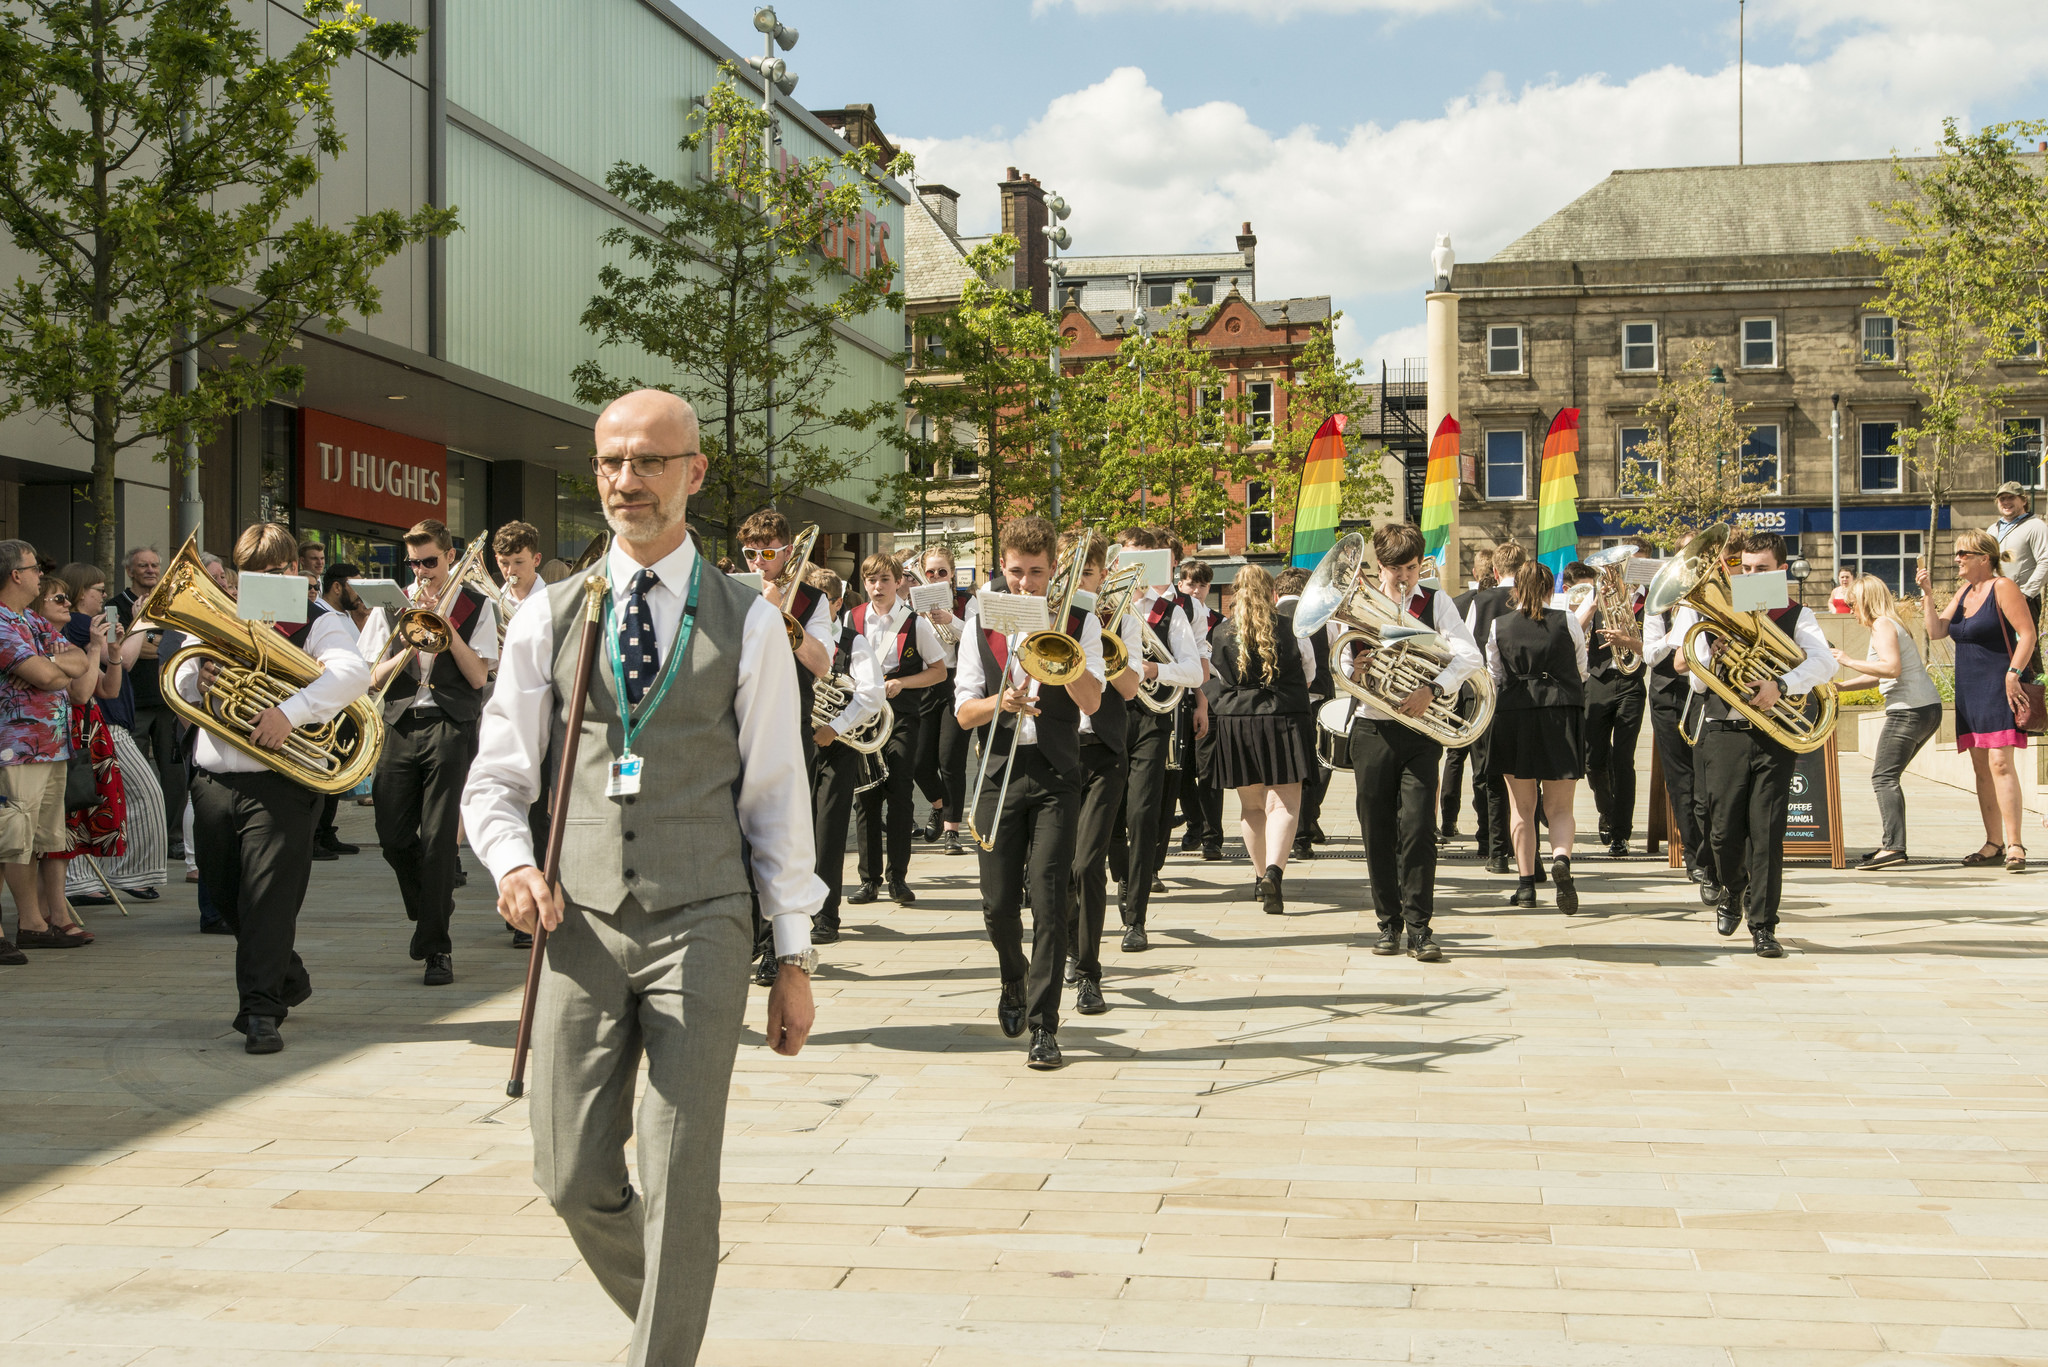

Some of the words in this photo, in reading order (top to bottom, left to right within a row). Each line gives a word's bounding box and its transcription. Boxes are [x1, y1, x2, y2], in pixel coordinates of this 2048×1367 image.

[316, 441, 343, 483] TJ
[351, 451, 441, 505] HUGHES
[1754, 512, 1785, 527] RBS
[1788, 803, 1812, 811] OFFEE
[1787, 815, 1813, 823] RUNCH
